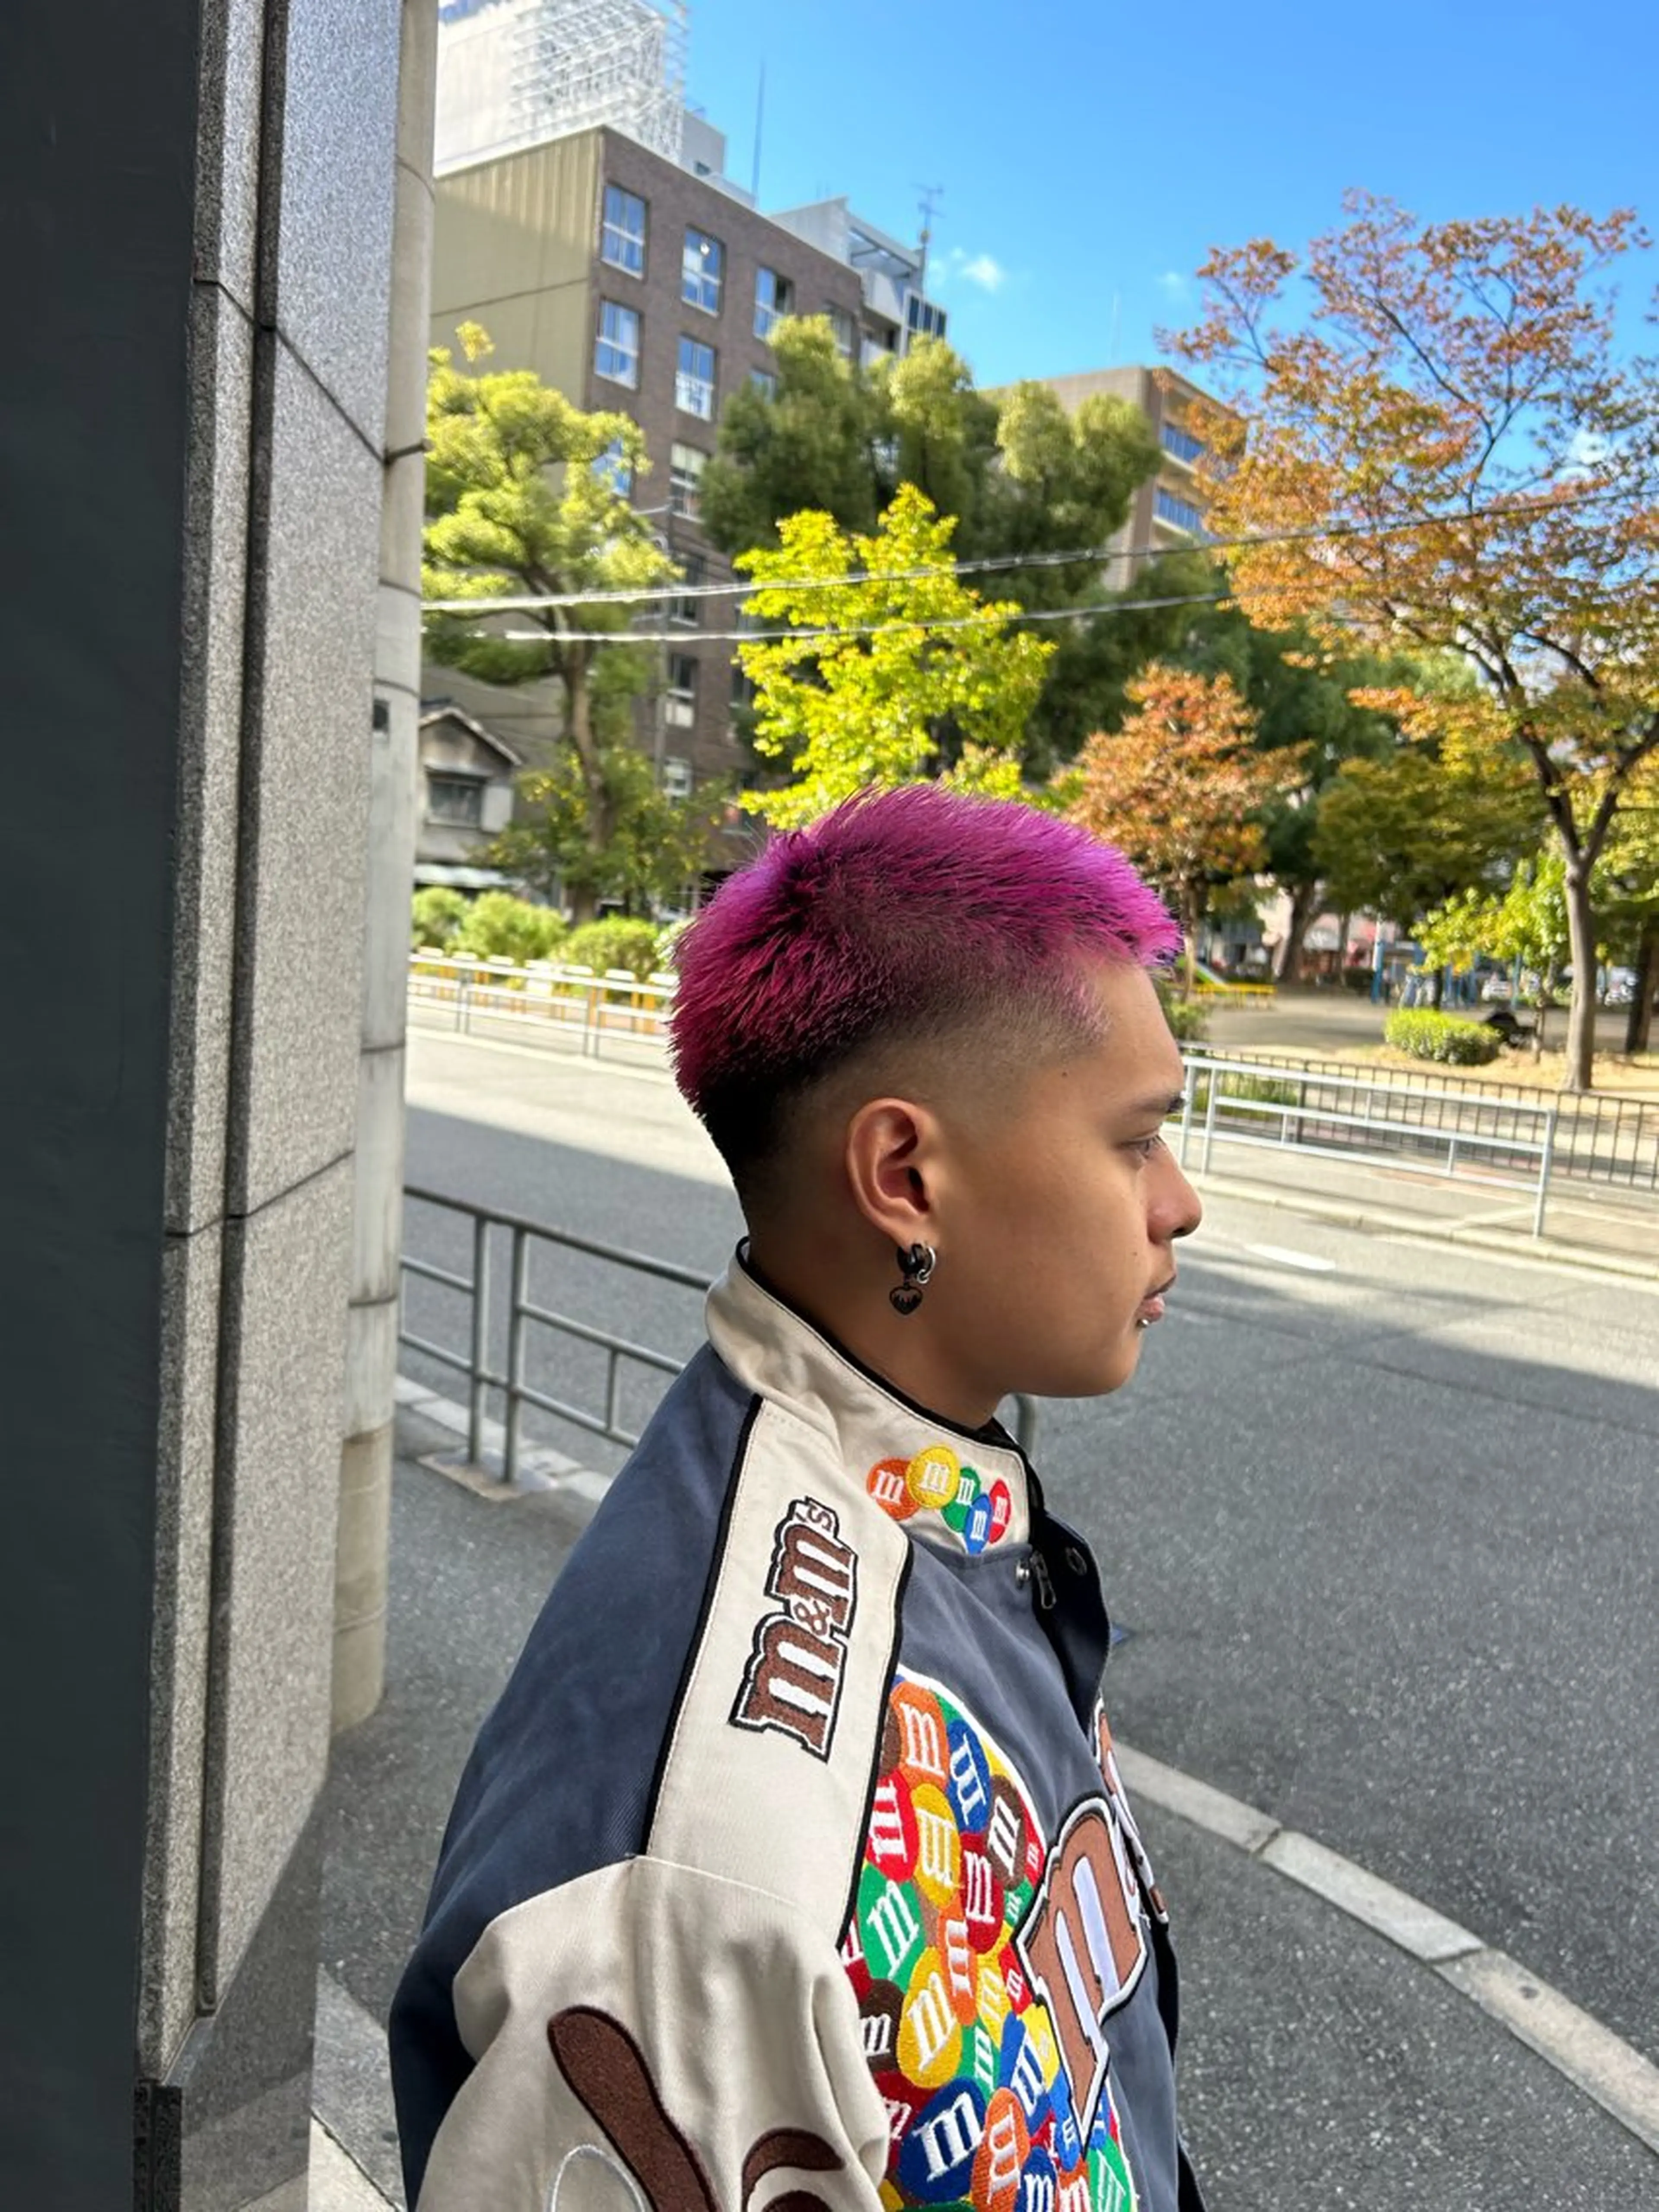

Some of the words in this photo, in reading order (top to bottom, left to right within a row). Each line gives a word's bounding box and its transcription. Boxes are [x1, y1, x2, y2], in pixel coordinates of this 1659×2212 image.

[871, 1470, 904, 1503] m
[919, 1462, 949, 1494] m
[956, 1478, 976, 1505] m
[970, 1510, 988, 1541] m
[900, 1703, 945, 1776] m
[950, 1733, 987, 1826] m
[871, 1779, 908, 1863] m
[916, 1808, 965, 1889] m
[987, 1795, 1021, 1877] m
[964, 1850, 995, 1923] m
[866, 1879, 919, 1980] m
[945, 1920, 974, 1999] m
[907, 1971, 957, 2072] m
[1010, 2028, 1046, 2118] m
[911, 2091, 985, 2183] m
[987, 2103, 1021, 2204] m
